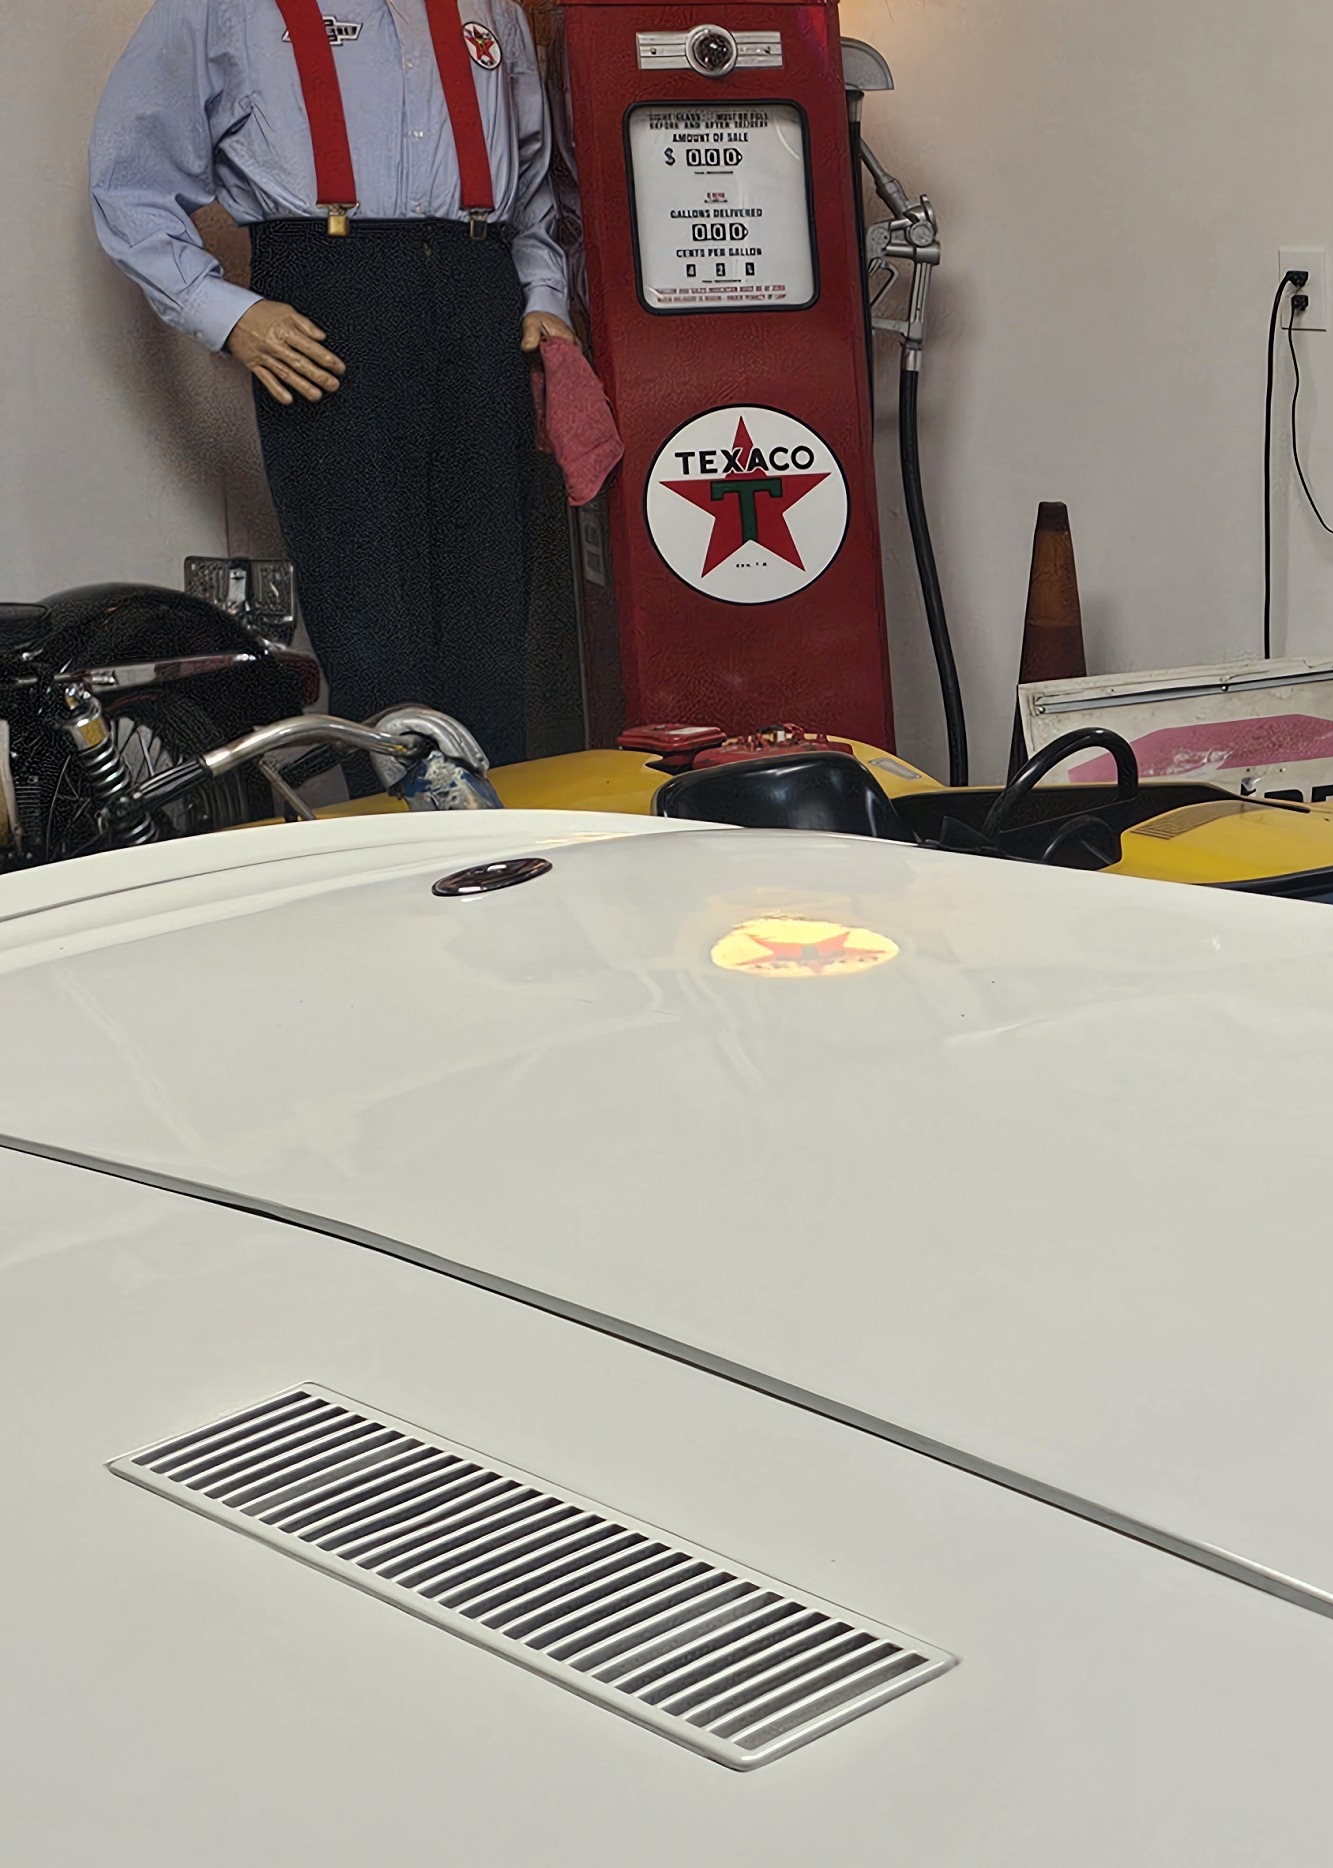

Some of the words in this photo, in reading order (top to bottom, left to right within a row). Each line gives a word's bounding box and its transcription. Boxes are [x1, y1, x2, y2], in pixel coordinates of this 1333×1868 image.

[672, 133, 710, 143] AMOUNT
[727, 132, 749, 142] SALE
[664, 147, 676, 166] $
[670, 209, 711, 219] GALLONS
[713, 208, 763, 218] DELIVERED
[674, 446, 815, 475] TEXACO
[710, 478, 783, 544] T
